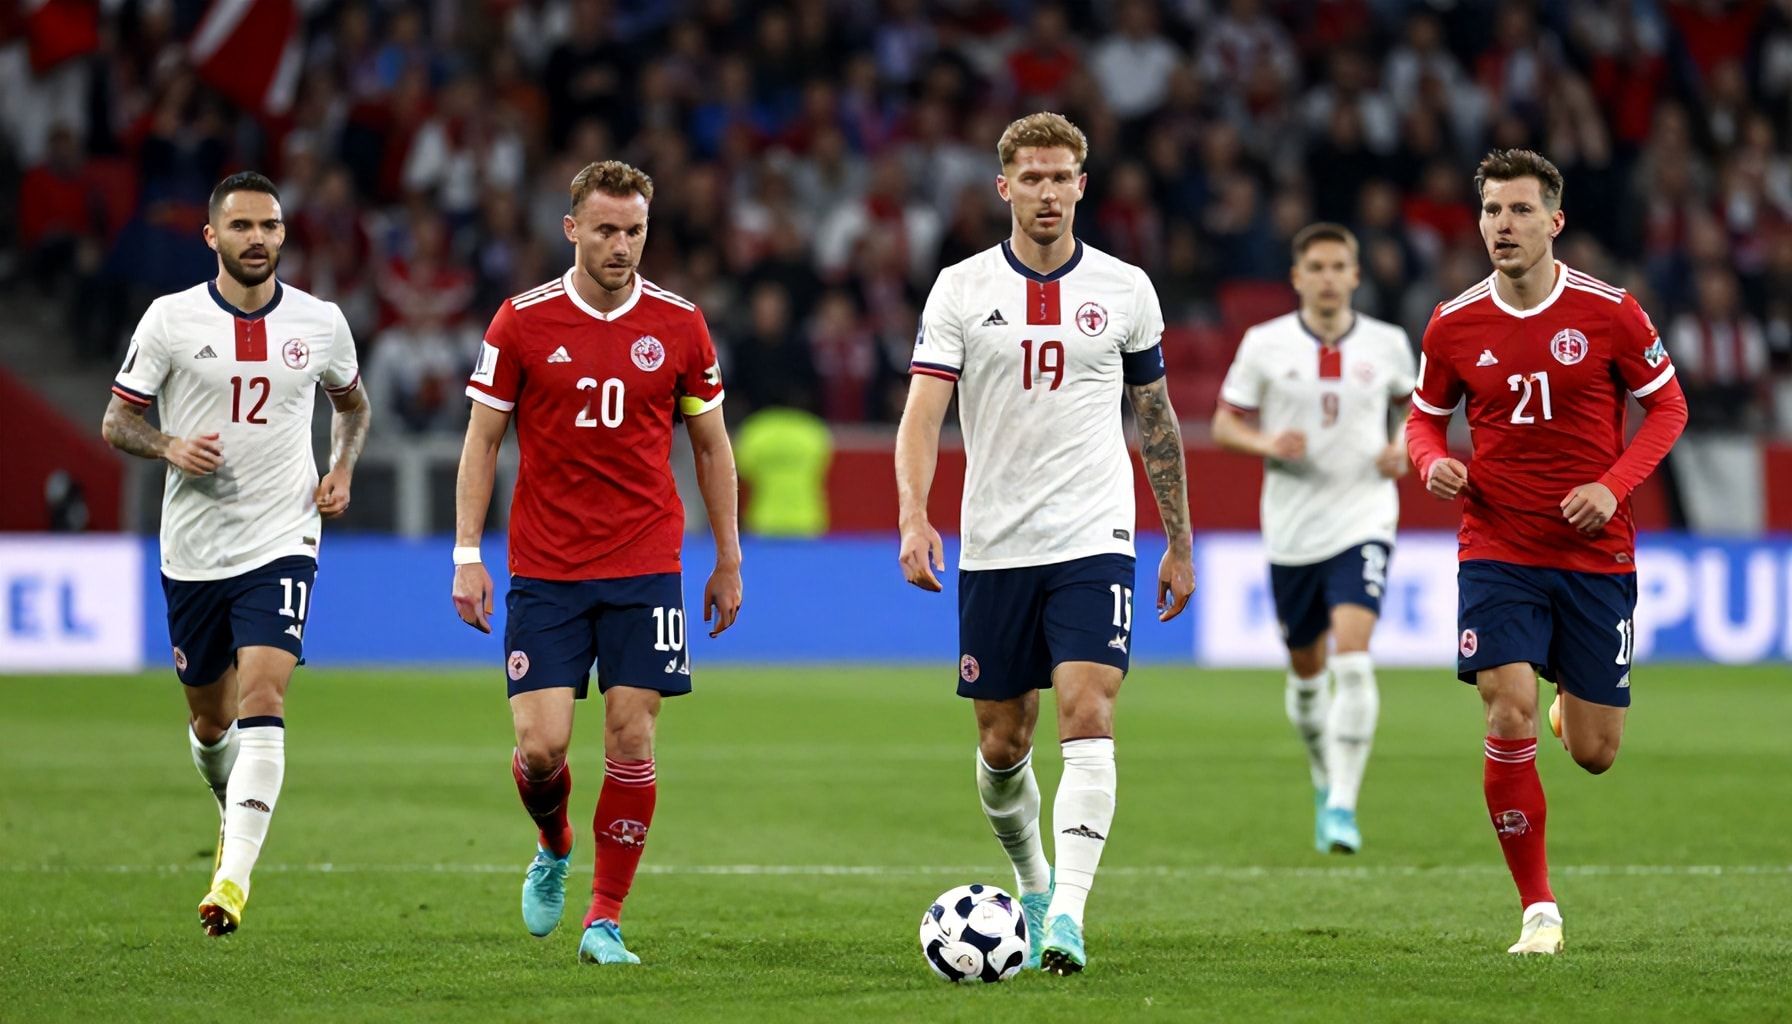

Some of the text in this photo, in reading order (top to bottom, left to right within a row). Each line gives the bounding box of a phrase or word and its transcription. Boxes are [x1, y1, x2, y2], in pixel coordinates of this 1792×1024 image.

[1020, 340, 1065, 391] 19
[230, 376, 271, 424] 12
[575, 377, 625, 428] 20
[1321, 391, 1340, 429] 9
[1507, 371, 1552, 424] 21
[279, 578, 307, 620] 11
[1634, 547, 1792, 664] PU
[652, 606, 684, 651] 10
